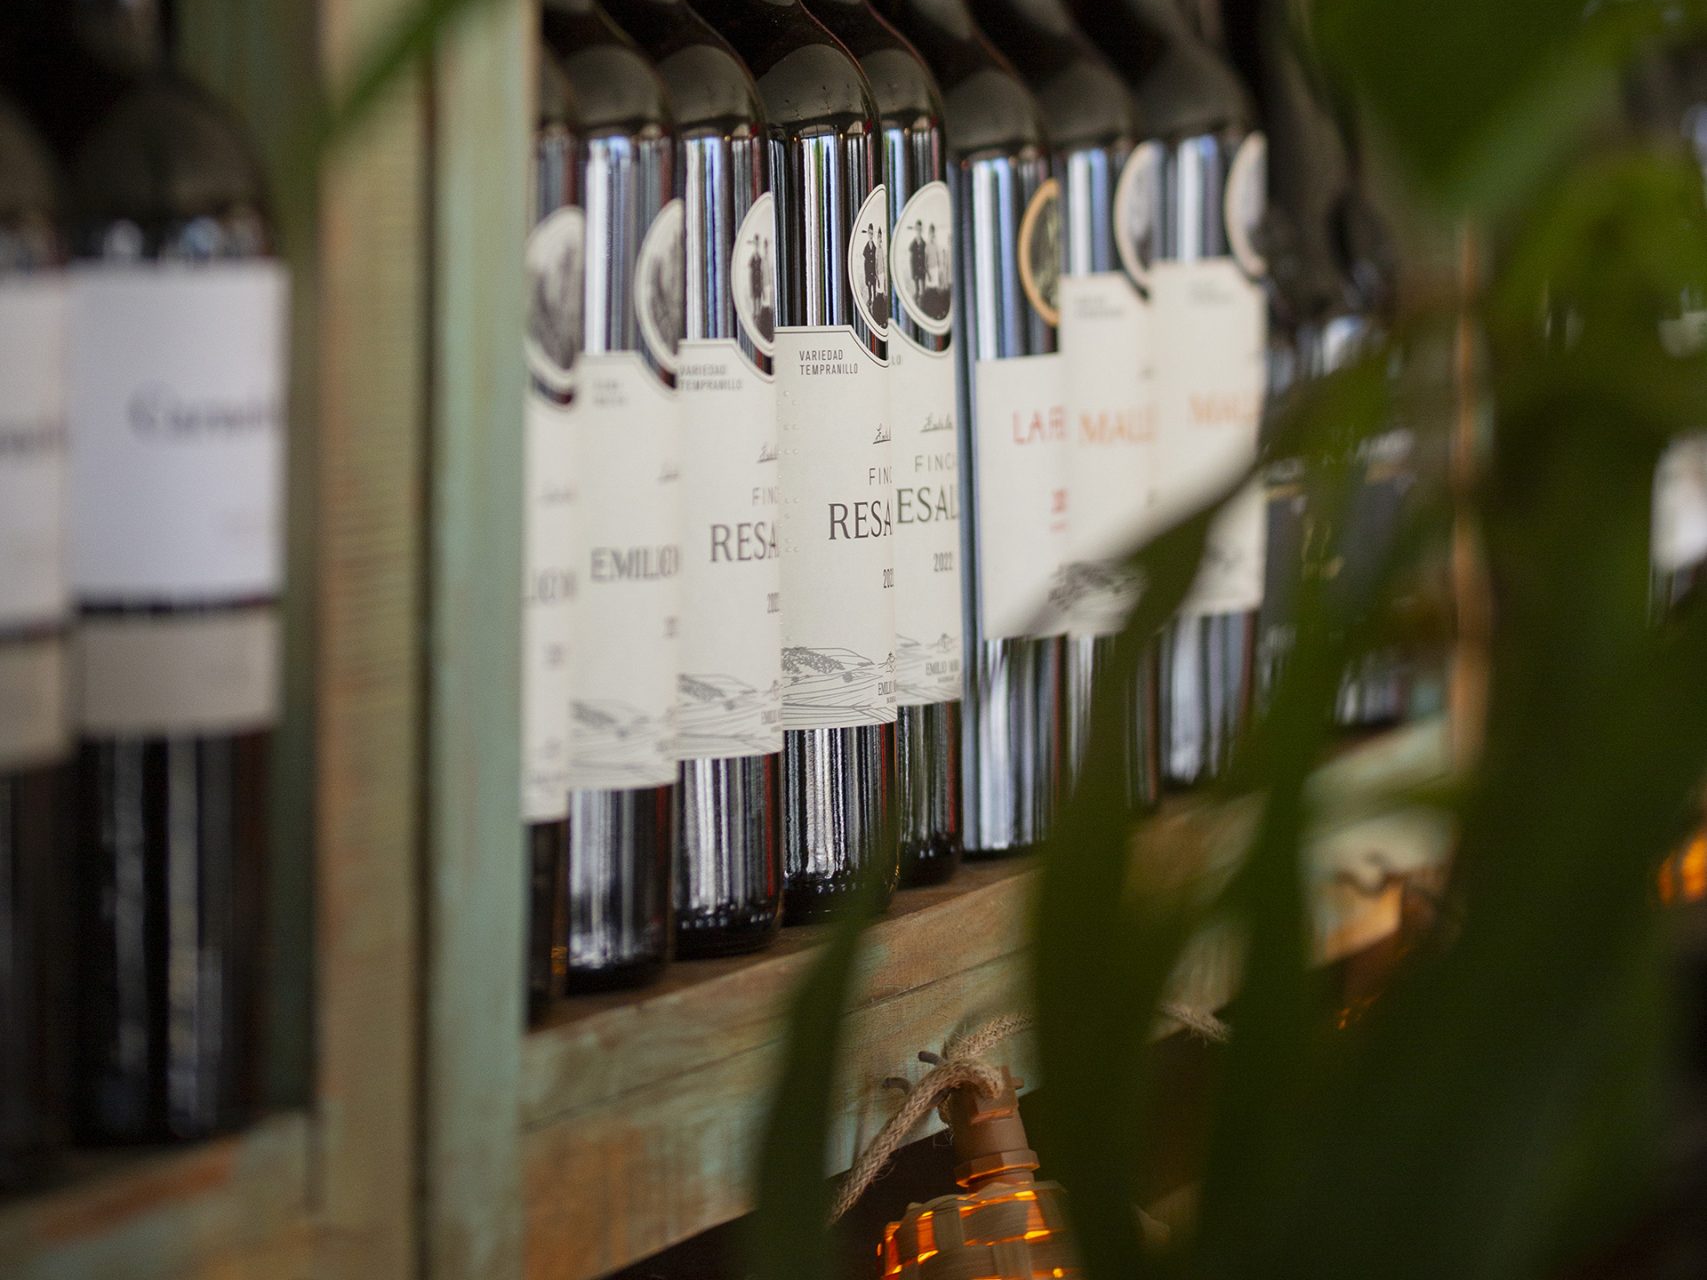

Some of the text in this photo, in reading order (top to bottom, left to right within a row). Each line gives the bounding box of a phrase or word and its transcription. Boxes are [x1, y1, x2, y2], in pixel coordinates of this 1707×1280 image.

[799, 349, 844, 362] VARIEDAD
[799, 363, 859, 376] TEMPRANILLO
[868, 467, 892, 486] FIN
[828, 499, 893, 540] RESA
[710, 521, 779, 563] RESA
